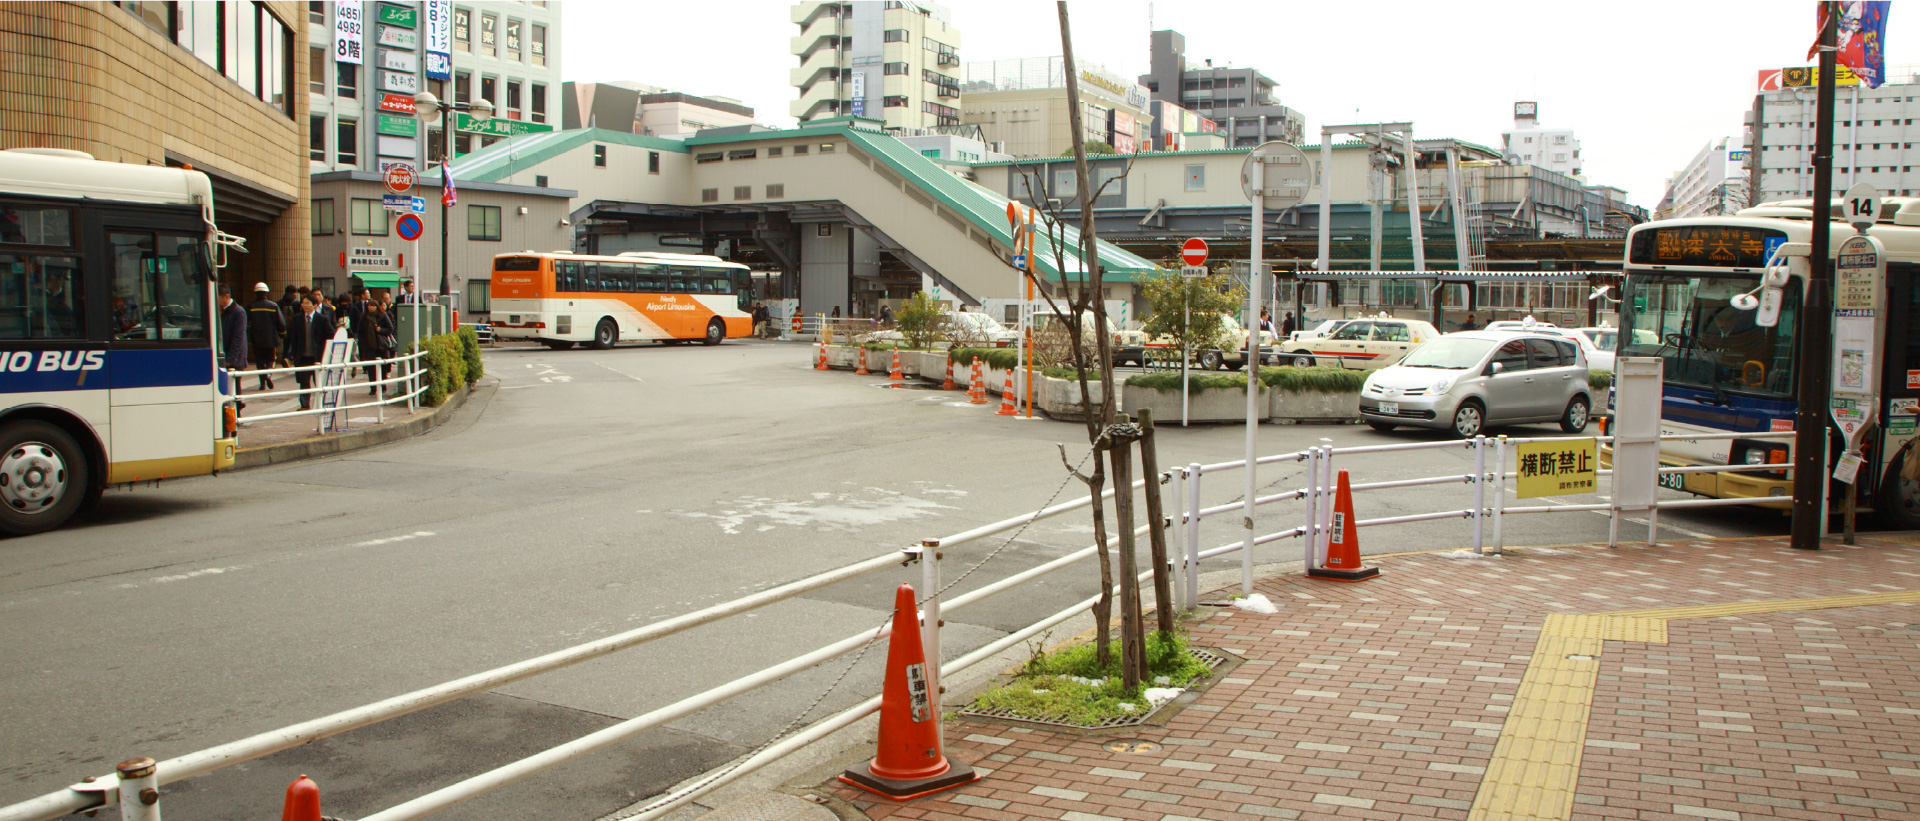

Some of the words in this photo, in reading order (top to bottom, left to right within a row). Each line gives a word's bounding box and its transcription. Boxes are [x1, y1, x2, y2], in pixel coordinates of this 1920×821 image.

[337, 5, 361, 21] (485)
[337, 20, 361, 35] 4982
[337, 38, 360, 59] 8階
[455, 26, 544, 54] 音楽教室
[390, 174, 411, 185] 消火栓
[1850, 197, 1873, 217] 14
[1681, 239, 1764, 256] 深大寺
[646, 302, 667, 312] Airport
[667, 302, 695, 311] Limousine
[0, 351, 33, 373] IO
[37, 350, 106, 372] BUS
[1520, 449, 1593, 478] 横断禁止
